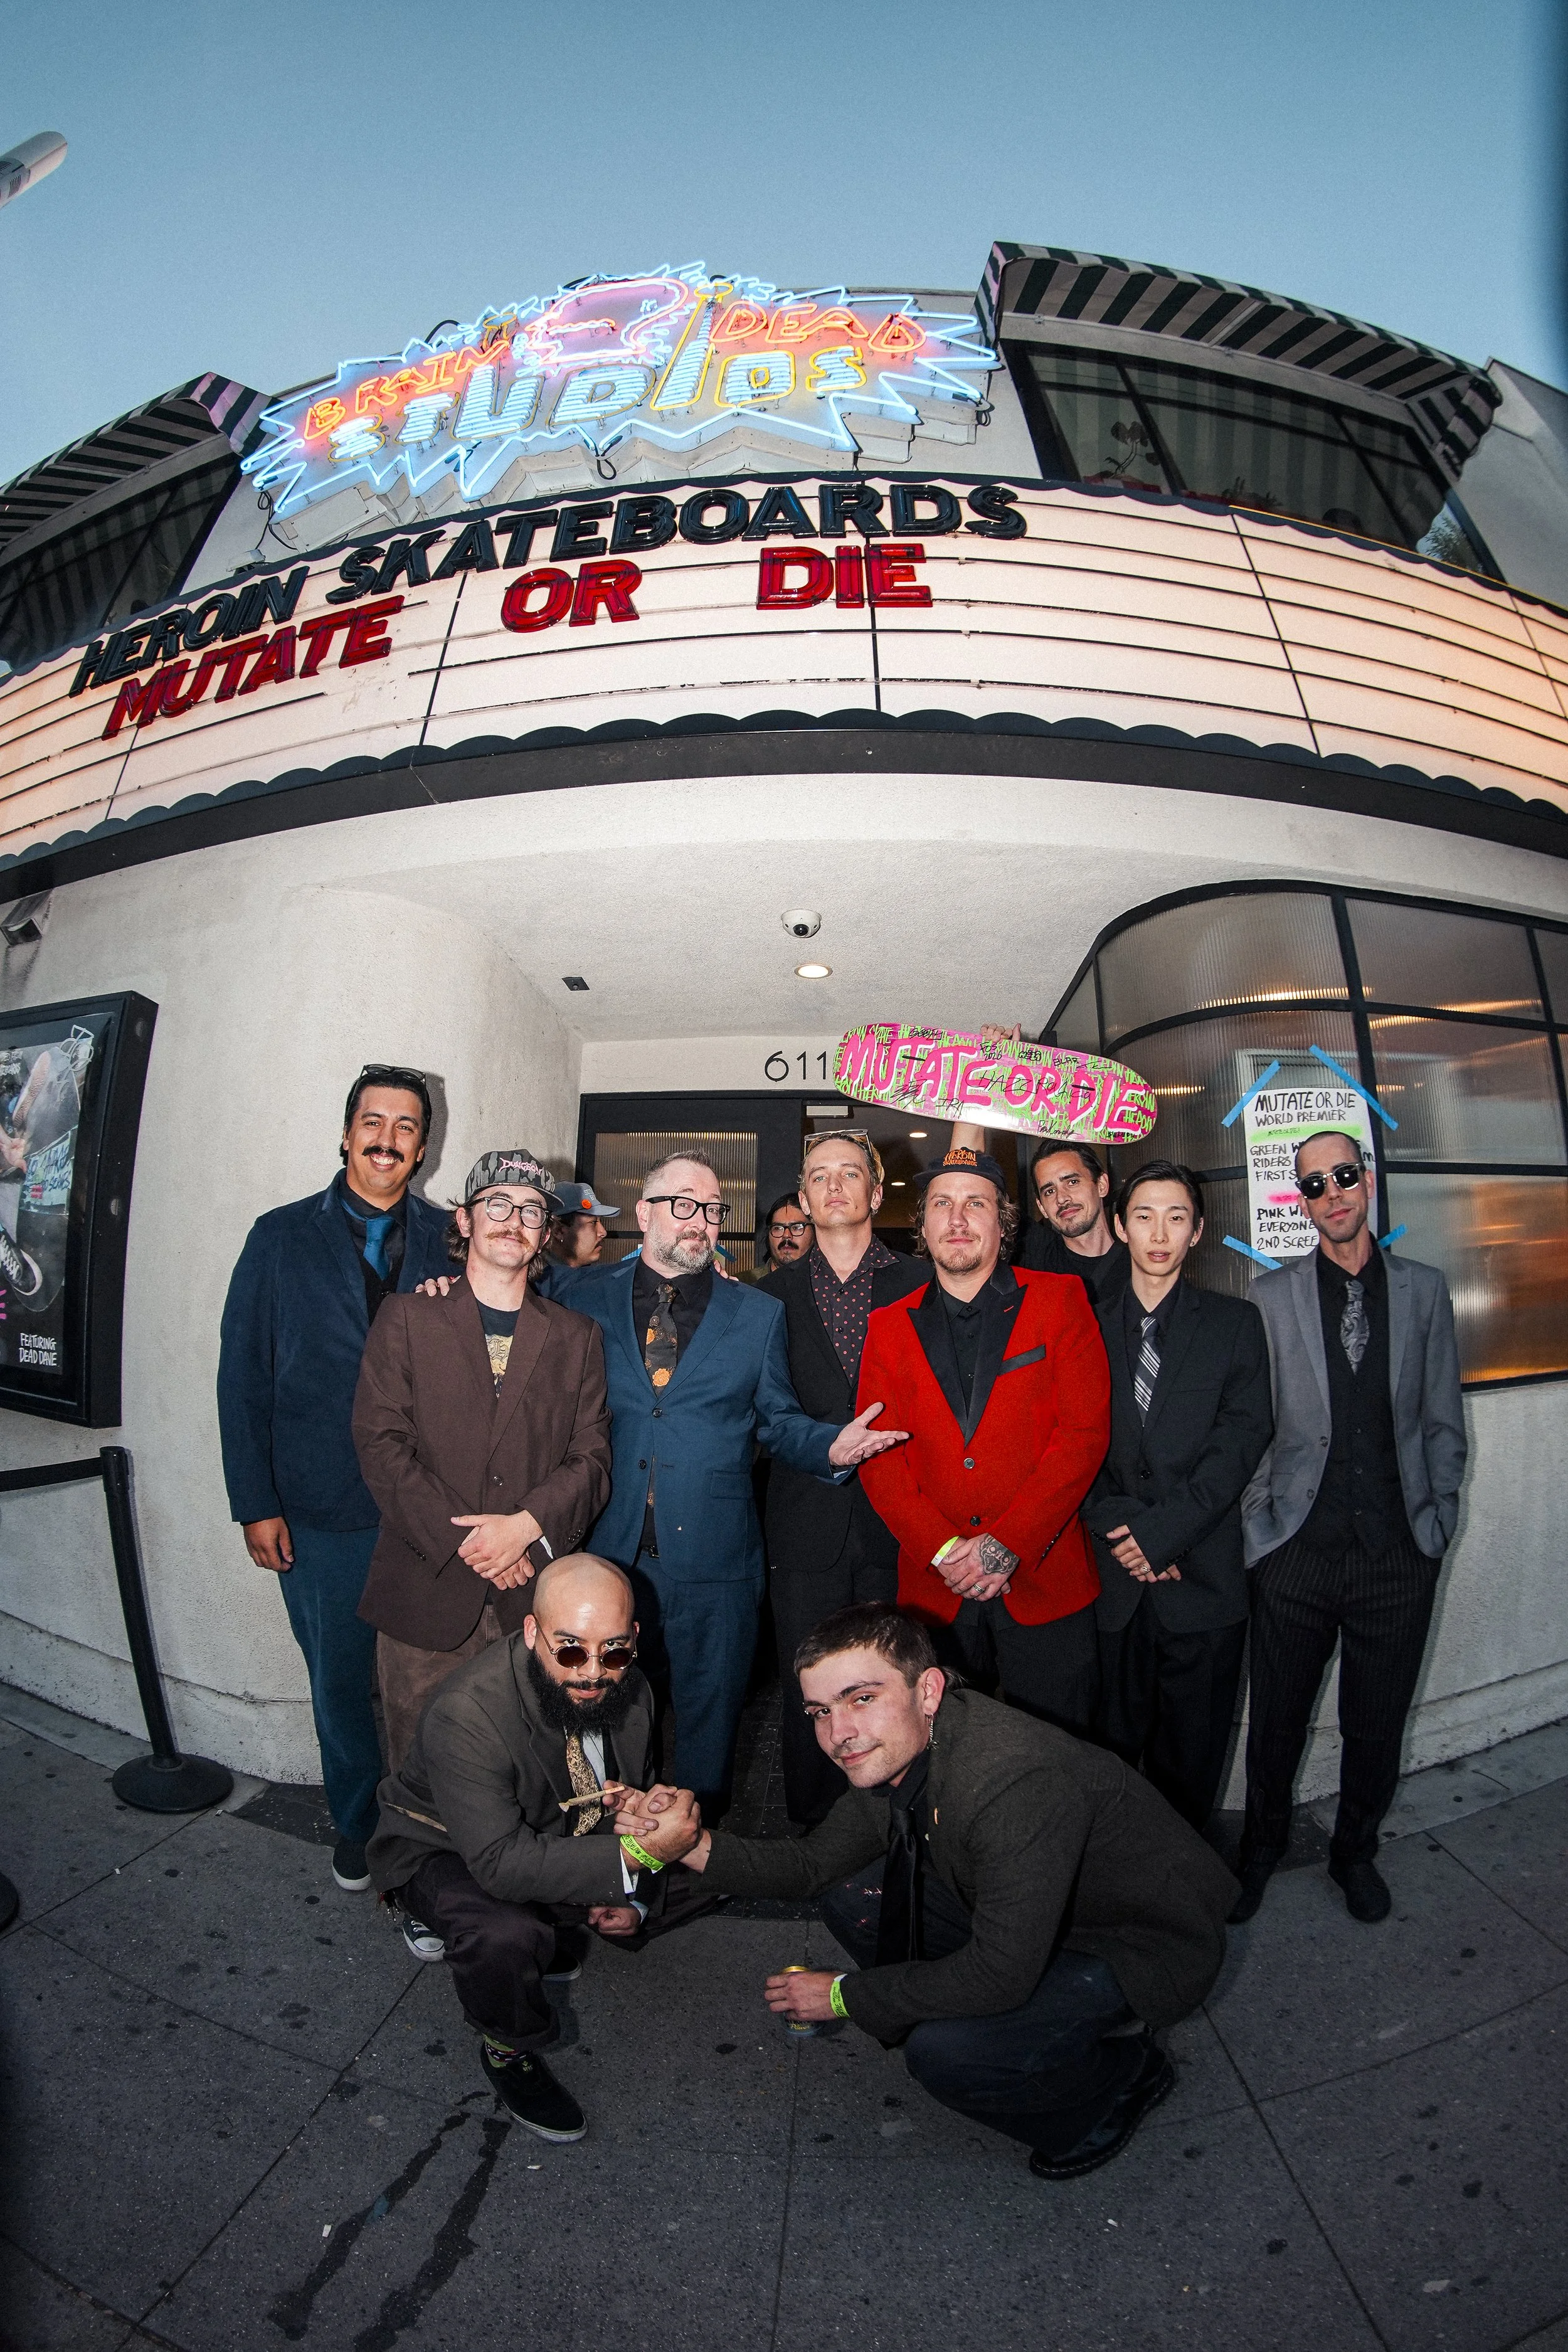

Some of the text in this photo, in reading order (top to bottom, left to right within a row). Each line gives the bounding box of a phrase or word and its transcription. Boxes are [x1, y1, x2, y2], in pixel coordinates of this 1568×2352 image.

[304, 300, 926, 440] BRAIN DEAD
[68, 482, 1028, 698] HEROIN SKATEBOARDS
[101, 542, 933, 741] MUTATE OR DIE
[764, 1050, 827, 1082] 611
[839, 1032, 998, 1109] MUTATE
[1005, 1064, 1062, 1118] OR
[1068, 1069, 1146, 1135] DIE
[1254, 1091, 1357, 1113] MUTATE OR DIE
[1255, 1108, 1346, 1127] WORLD PREMIER
[944, 1149, 977, 1162] HEROIN
[1250, 1143, 1287, 1157] GREEN
[499, 1157, 543, 1176] DUNGEON
[1256, 1170, 1288, 1182] FIRST
[1256, 1207, 1286, 1221] PINK
[1259, 1220, 1316, 1233] EVERYONE
[1256, 1235, 1318, 1251] 2ND SCREE
[20, 1332, 57, 1350] FEATURING
[19, 1347, 58, 1366] DEAD DAVE
